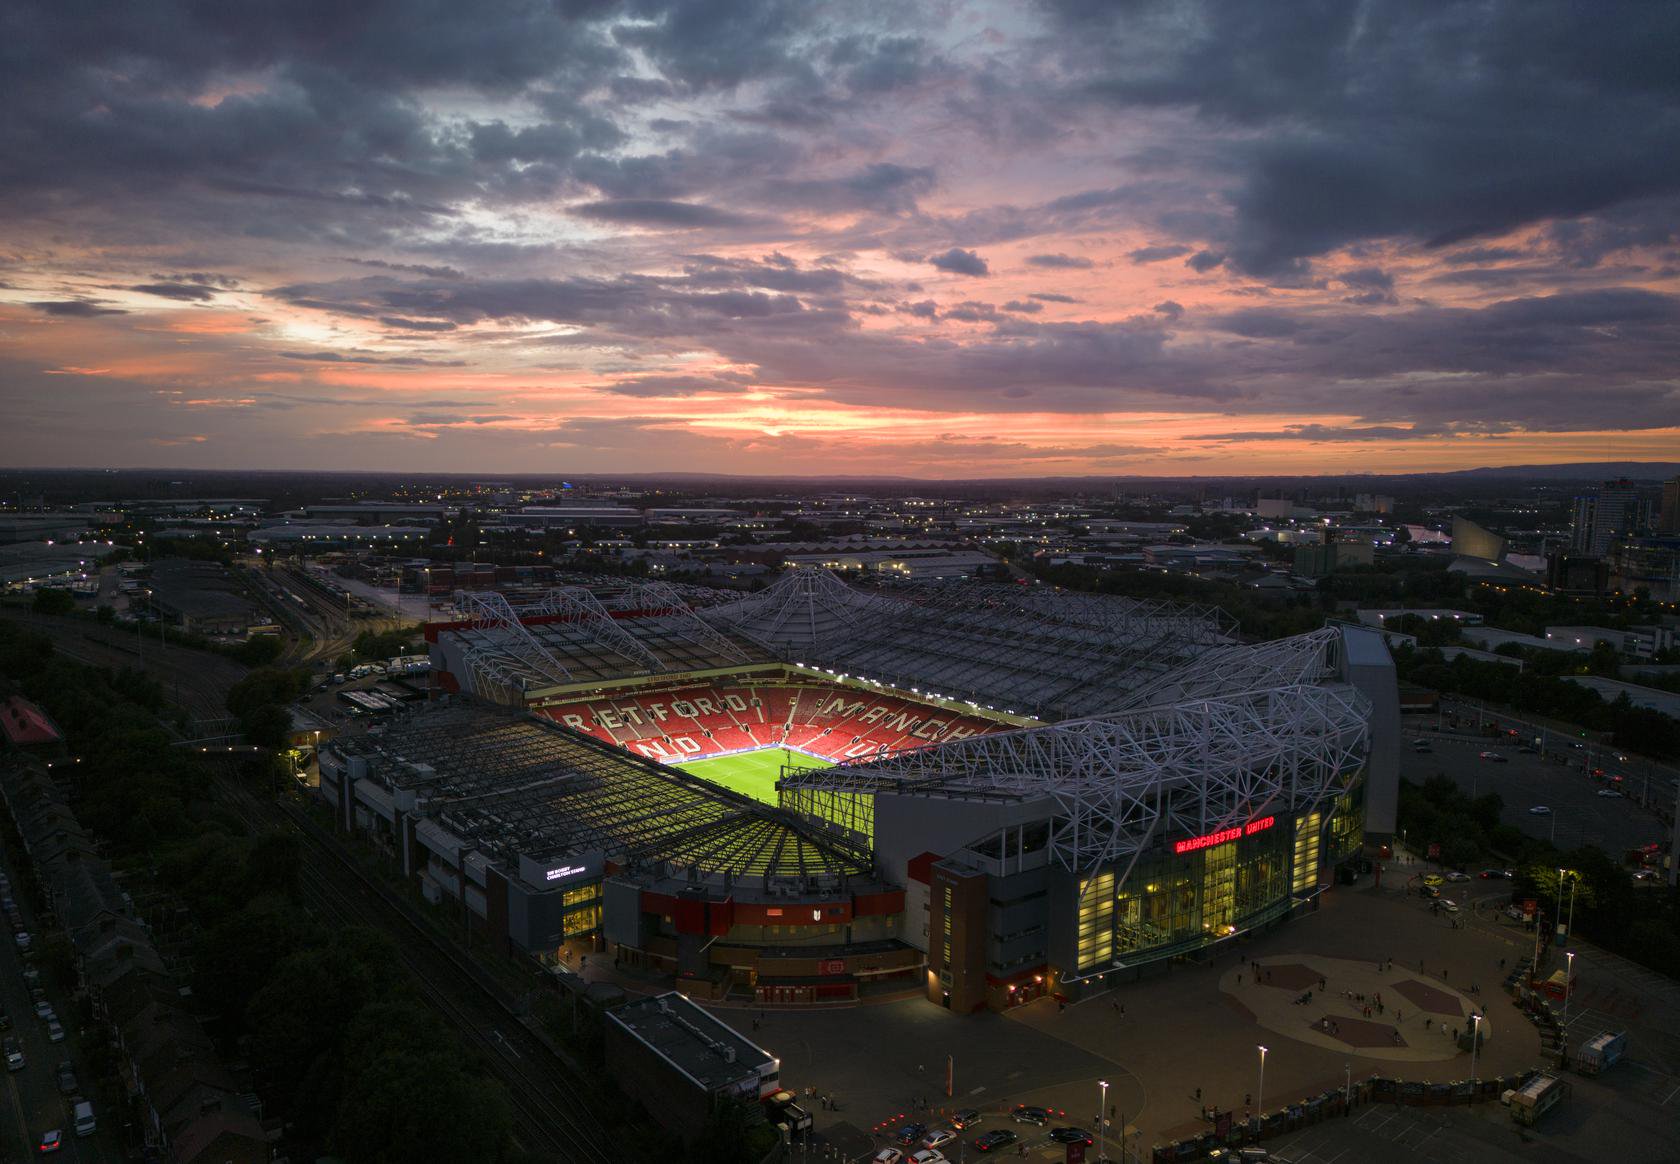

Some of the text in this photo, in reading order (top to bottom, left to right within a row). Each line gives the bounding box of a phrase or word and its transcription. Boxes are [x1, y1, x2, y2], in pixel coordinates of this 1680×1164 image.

[1176, 816, 1275, 853] MANCHESTER UNITED
[547, 866, 585, 880] CHARLTON STAND
